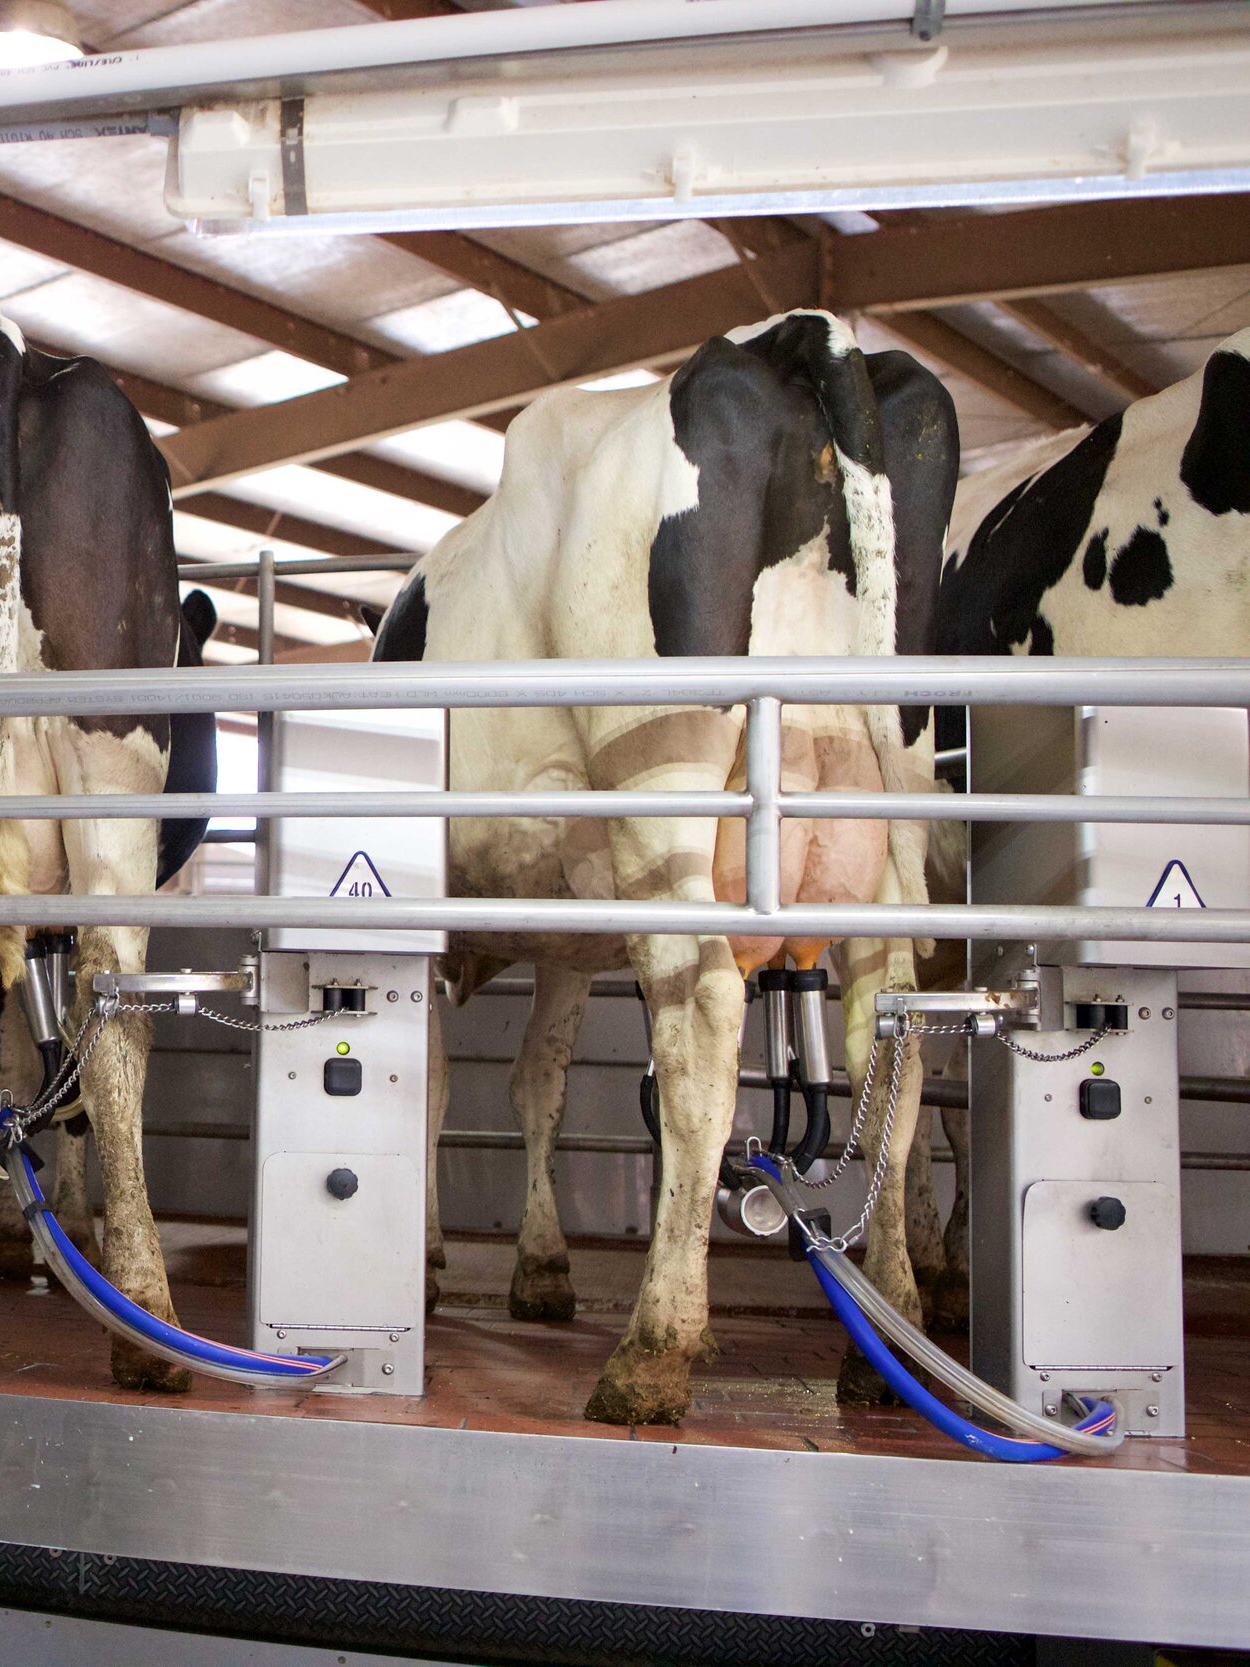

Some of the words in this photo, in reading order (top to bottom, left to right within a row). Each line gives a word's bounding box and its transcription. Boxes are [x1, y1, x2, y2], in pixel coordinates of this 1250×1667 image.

[40, 63, 59, 72] PVC
[38, 130, 52, 139] 40
[60, 128, 82, 138] SCH
[903, 689, 972, 697] FROCH
[348, 882, 373, 897] 40
[1173, 893, 1182, 908] 1
